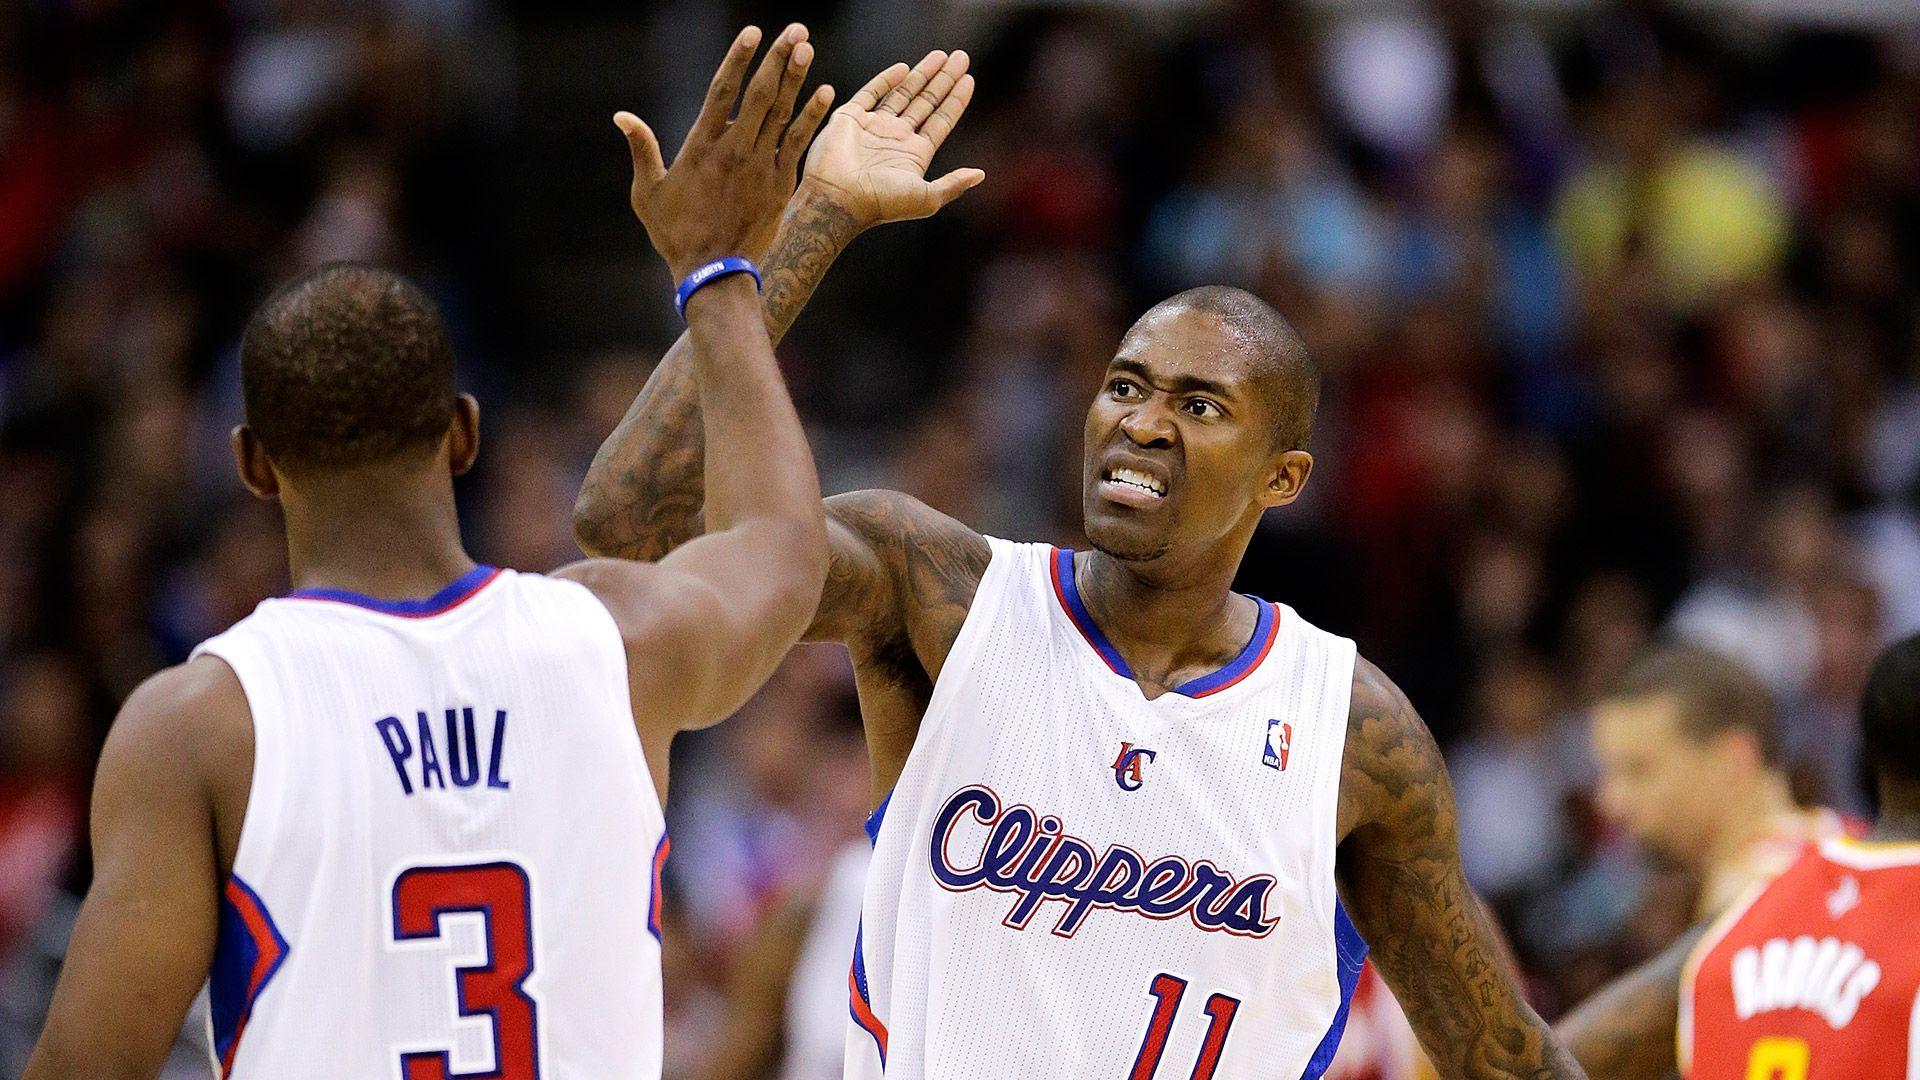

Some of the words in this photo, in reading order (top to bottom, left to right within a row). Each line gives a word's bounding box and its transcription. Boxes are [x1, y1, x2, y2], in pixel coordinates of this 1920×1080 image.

[375, 706, 511, 795] PAUL
[928, 784, 1281, 939] Clippers
[391, 861, 540, 1080] 3
[1127, 972, 1241, 1080] 11
